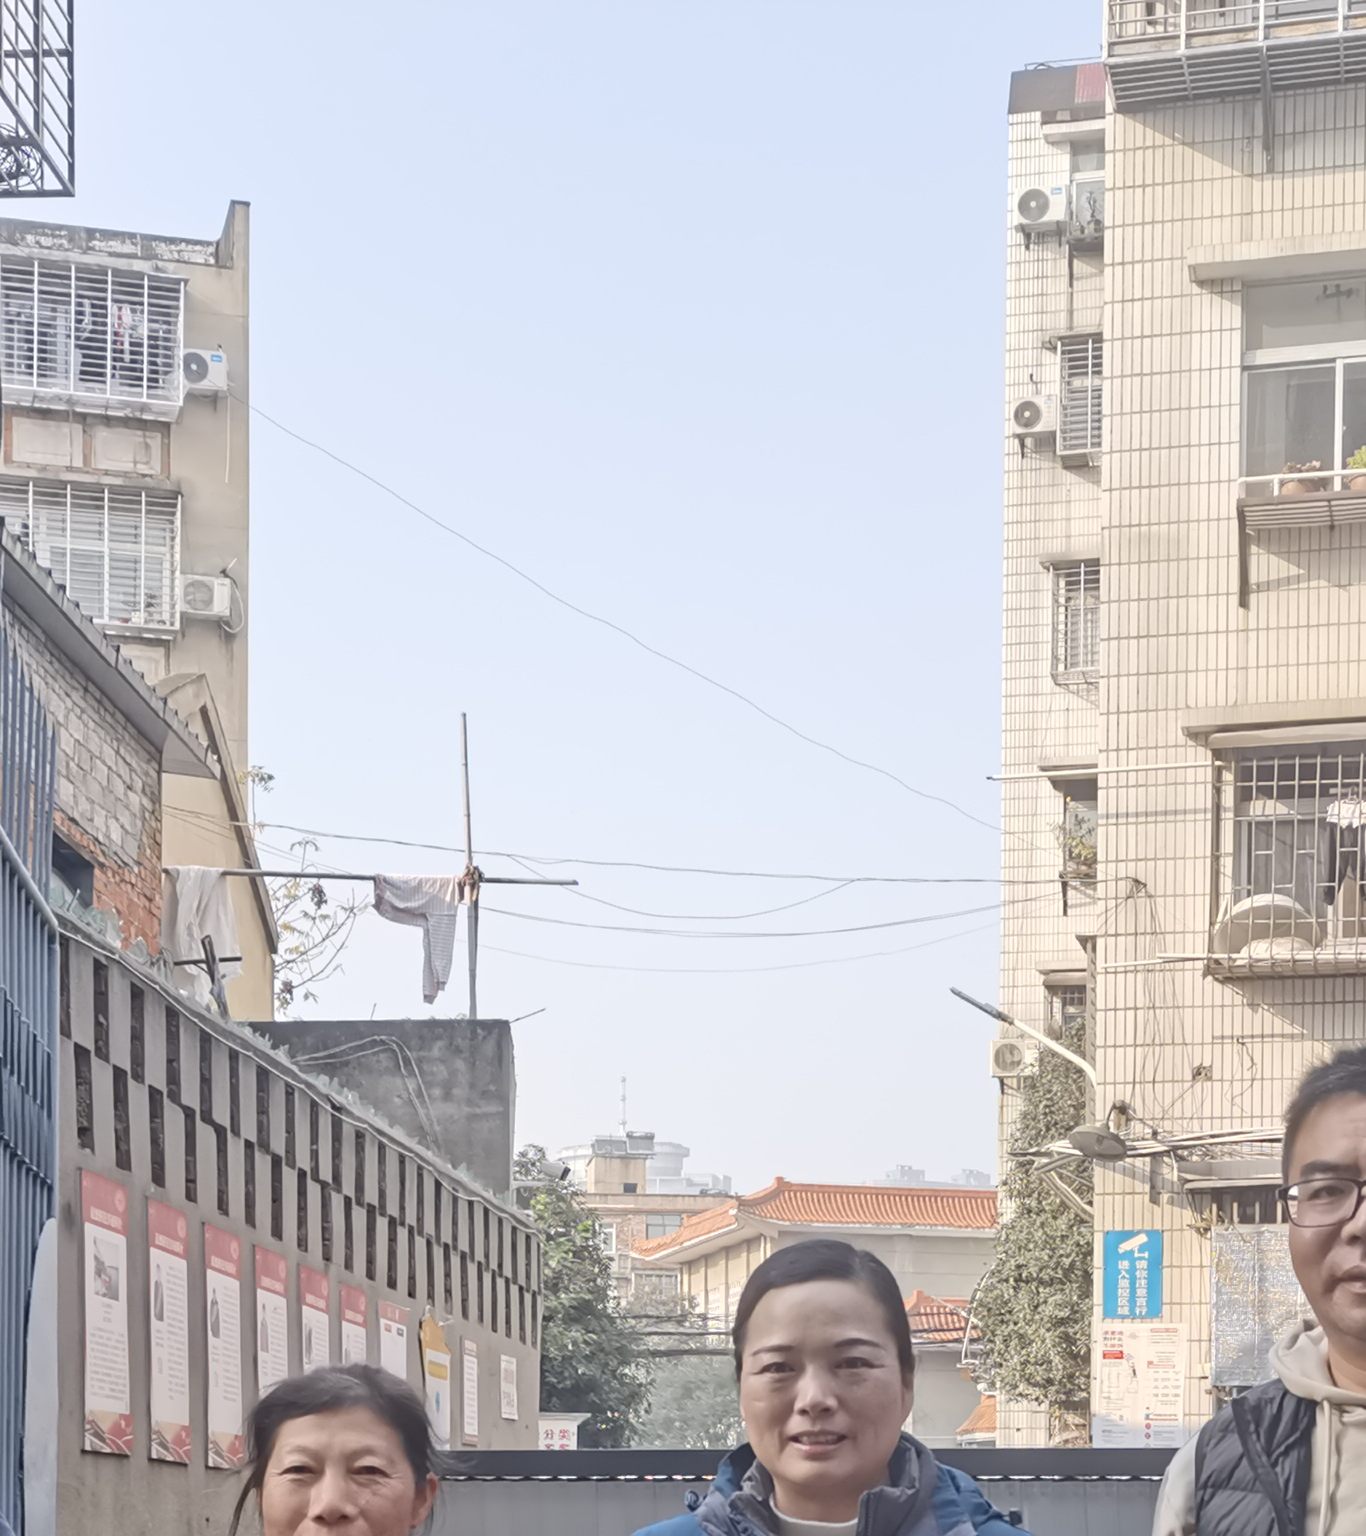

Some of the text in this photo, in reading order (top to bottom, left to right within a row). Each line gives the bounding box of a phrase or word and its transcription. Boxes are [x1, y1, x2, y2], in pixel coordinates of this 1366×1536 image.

[1117, 1260, 1130, 1315] 进入监控区域
